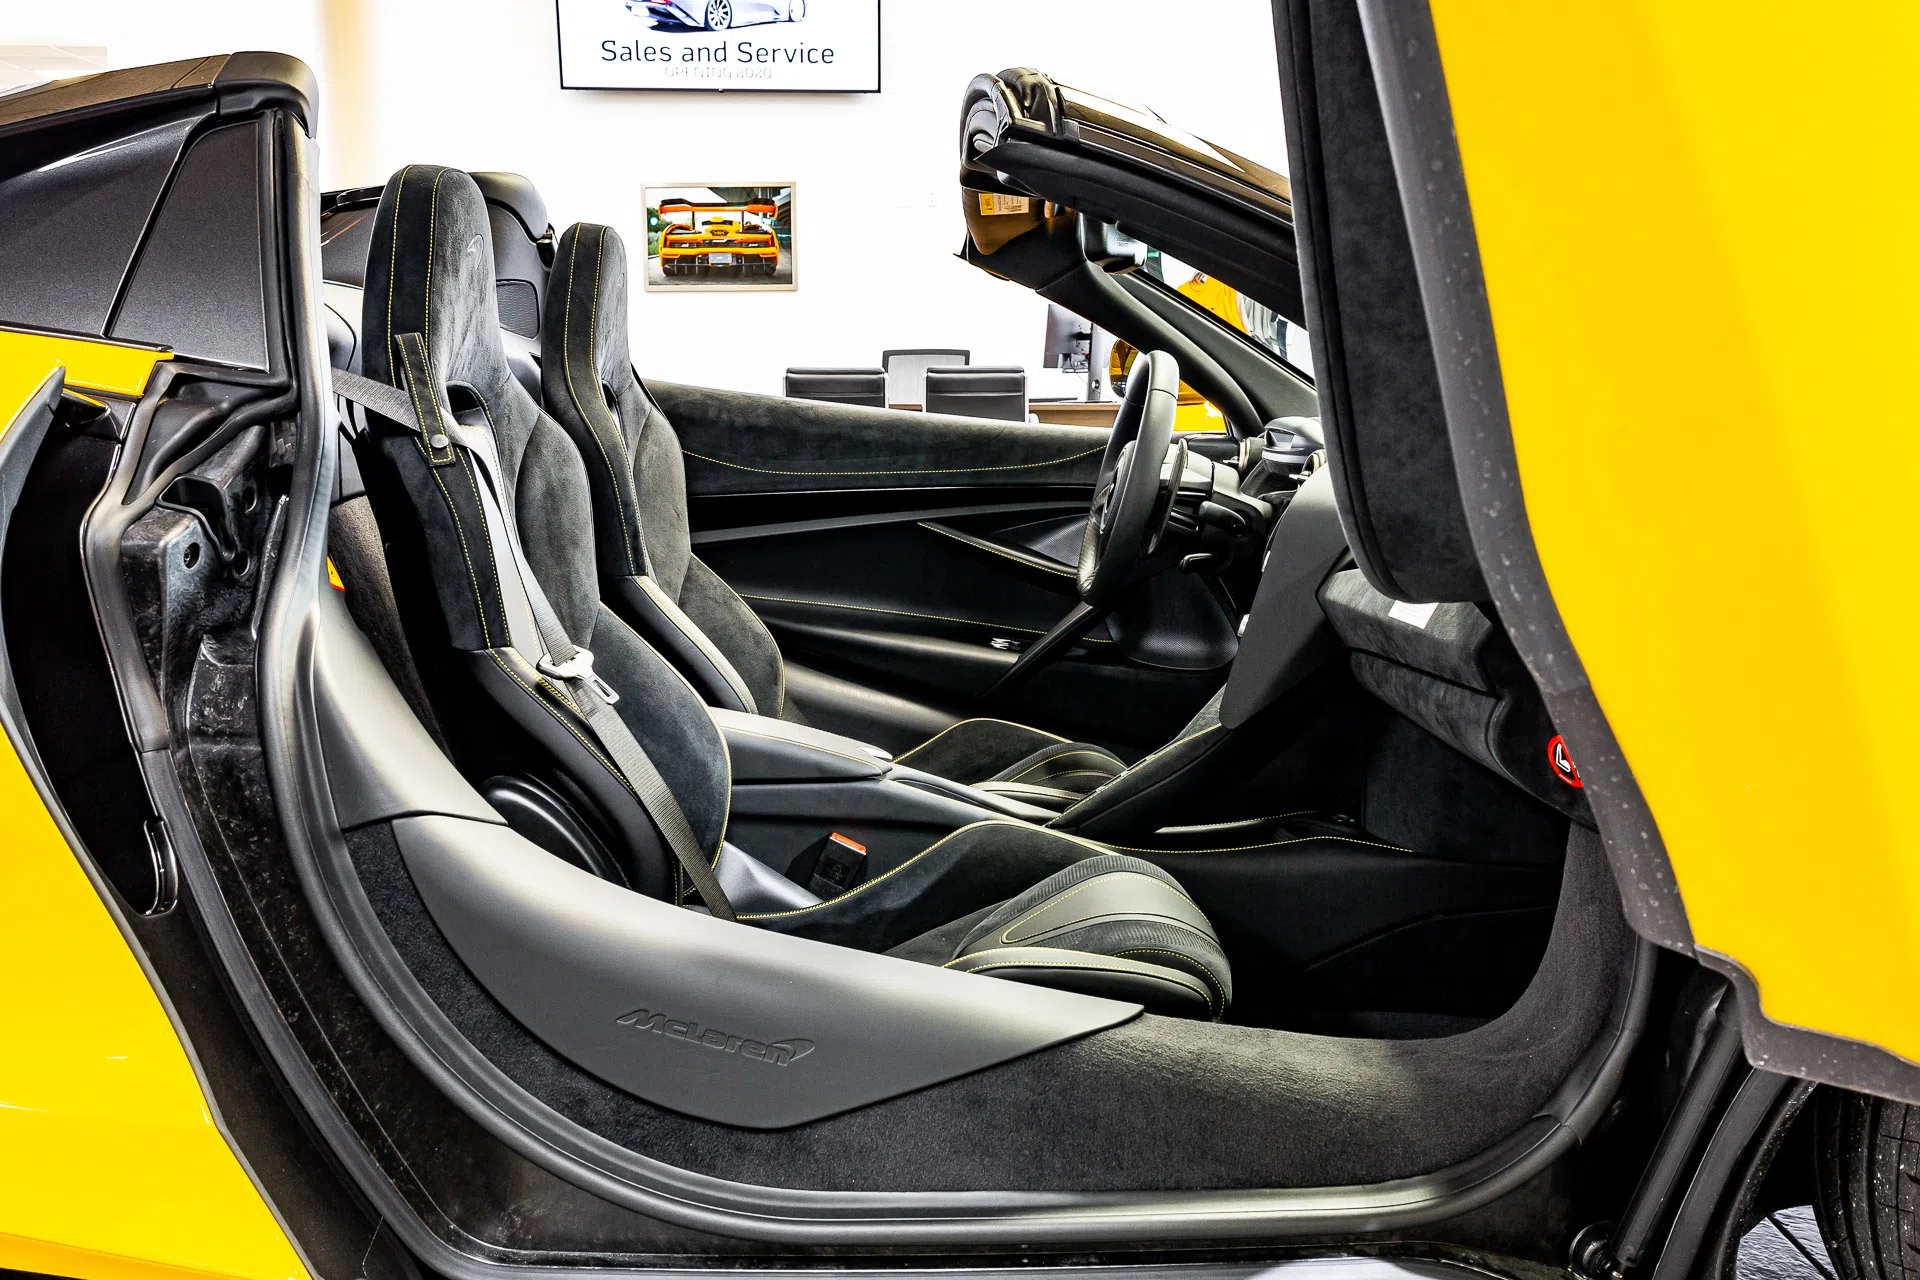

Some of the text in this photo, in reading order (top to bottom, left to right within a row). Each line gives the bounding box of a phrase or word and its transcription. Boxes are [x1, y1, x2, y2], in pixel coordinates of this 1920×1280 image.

[601, 39, 835, 64] Sales and Service
[664, 66, 772, 79] OPENING 2020
[615, 1008, 796, 1067] McLaren
